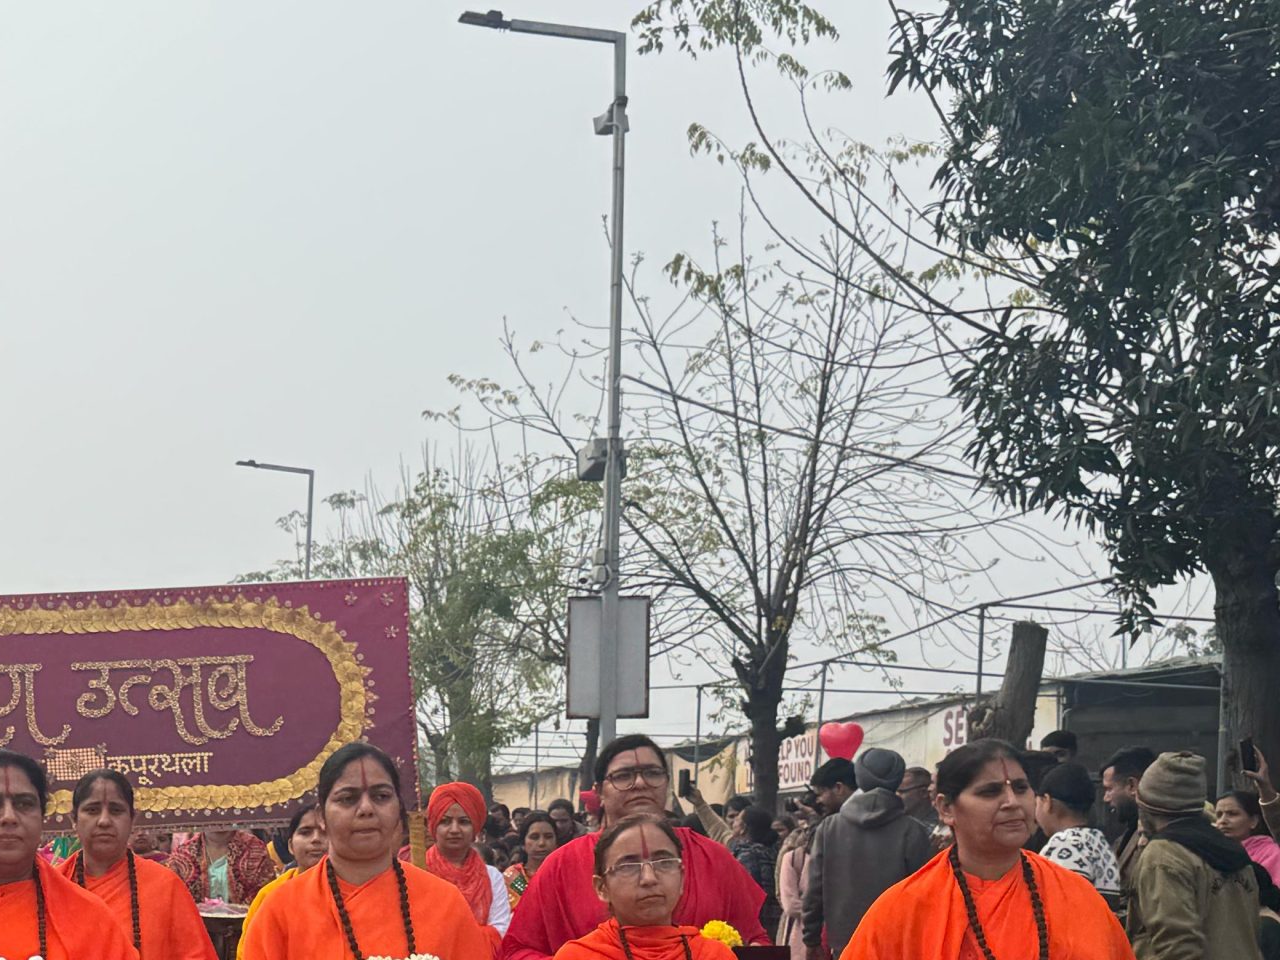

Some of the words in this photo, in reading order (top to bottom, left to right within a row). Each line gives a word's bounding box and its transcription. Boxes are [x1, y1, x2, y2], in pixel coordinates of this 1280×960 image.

[71, 654, 284, 745] उत्सव
[794, 736, 814, 759] YOU
[106, 752, 214, 785] कपूरथला
